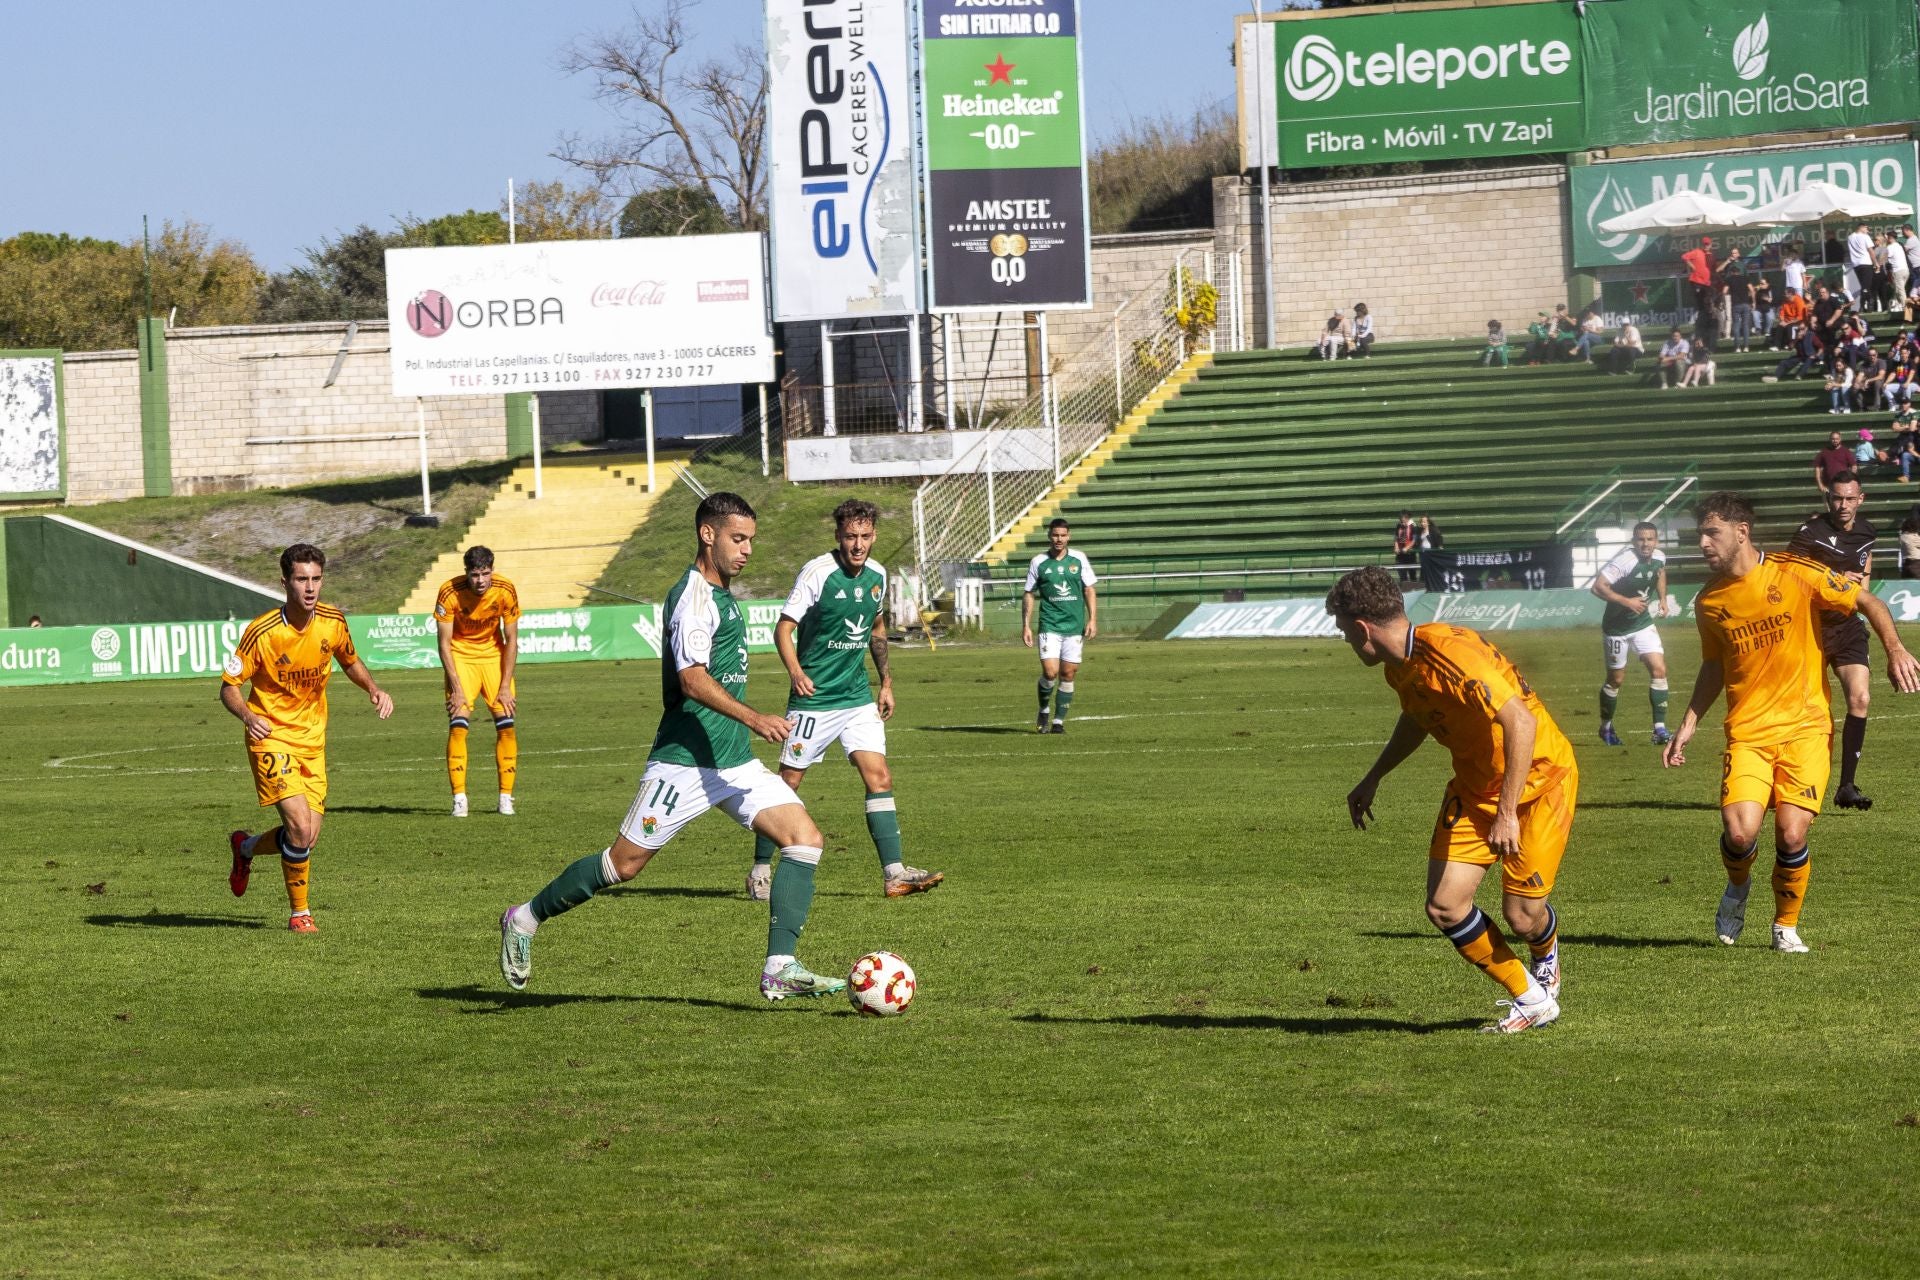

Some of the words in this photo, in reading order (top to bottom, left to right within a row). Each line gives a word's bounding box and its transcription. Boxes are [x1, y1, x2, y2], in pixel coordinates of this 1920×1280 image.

[940, 14, 969, 35] SIN
[970, 13, 1032, 35] FILTRAR
[1033, 13, 1061, 35] 0,0
[1346, 39, 1572, 89] teleporte
[942, 93, 1060, 117] Heineken
[1633, 73, 1870, 124] JardineríaSara
[851, 71, 869, 176] CÁCERES
[1306, 131, 1365, 153] Fibra
[1384, 124, 1446, 149] Móvil
[1463, 122, 1496, 144] TV
[1501, 117, 1553, 145] Zapi
[985, 124, 1020, 150] 0.0
[1651, 158, 1905, 209] MÁSMEDIO
[966, 199, 1052, 220] AMSTEL
[948, 223, 1007, 232] PREMIUM
[1012, 221, 1067, 231] QUALITY
[1669, 237, 1721, 252] AGUS
[1726, 230, 1806, 249] PROVINCIA
[990, 257, 1026, 287] 0,0
[405, 360, 423, 370] Pol.
[426, 358, 472, 370] Industrial
[475, 357, 490, 368] Las
[553, 353, 565, 366] C/
[633, 353, 656, 361] nave
[659, 350, 665, 360] 3
[674, 348, 703, 360] 10005
[706, 345, 757, 358] CÁCERES
[449, 374, 488, 387] TELF.
[492, 373, 518, 386] 927
[524, 372, 549, 384] 113
[555, 370, 581, 383] 100
[594, 368, 622, 381] FAX
[625, 367, 651, 380] 927
[657, 366, 683, 379] 230
[688, 364, 714, 377] 727
[377, 616, 415, 628] DIEGO
[1193, 606, 1287, 632] JAVIER
[366, 626, 427, 639] ALVARADO
[129, 622, 250, 675] IMPULS
[795, 713, 816, 740] 10
[263, 752, 292, 779] 22
[649, 778, 680, 817] 14
